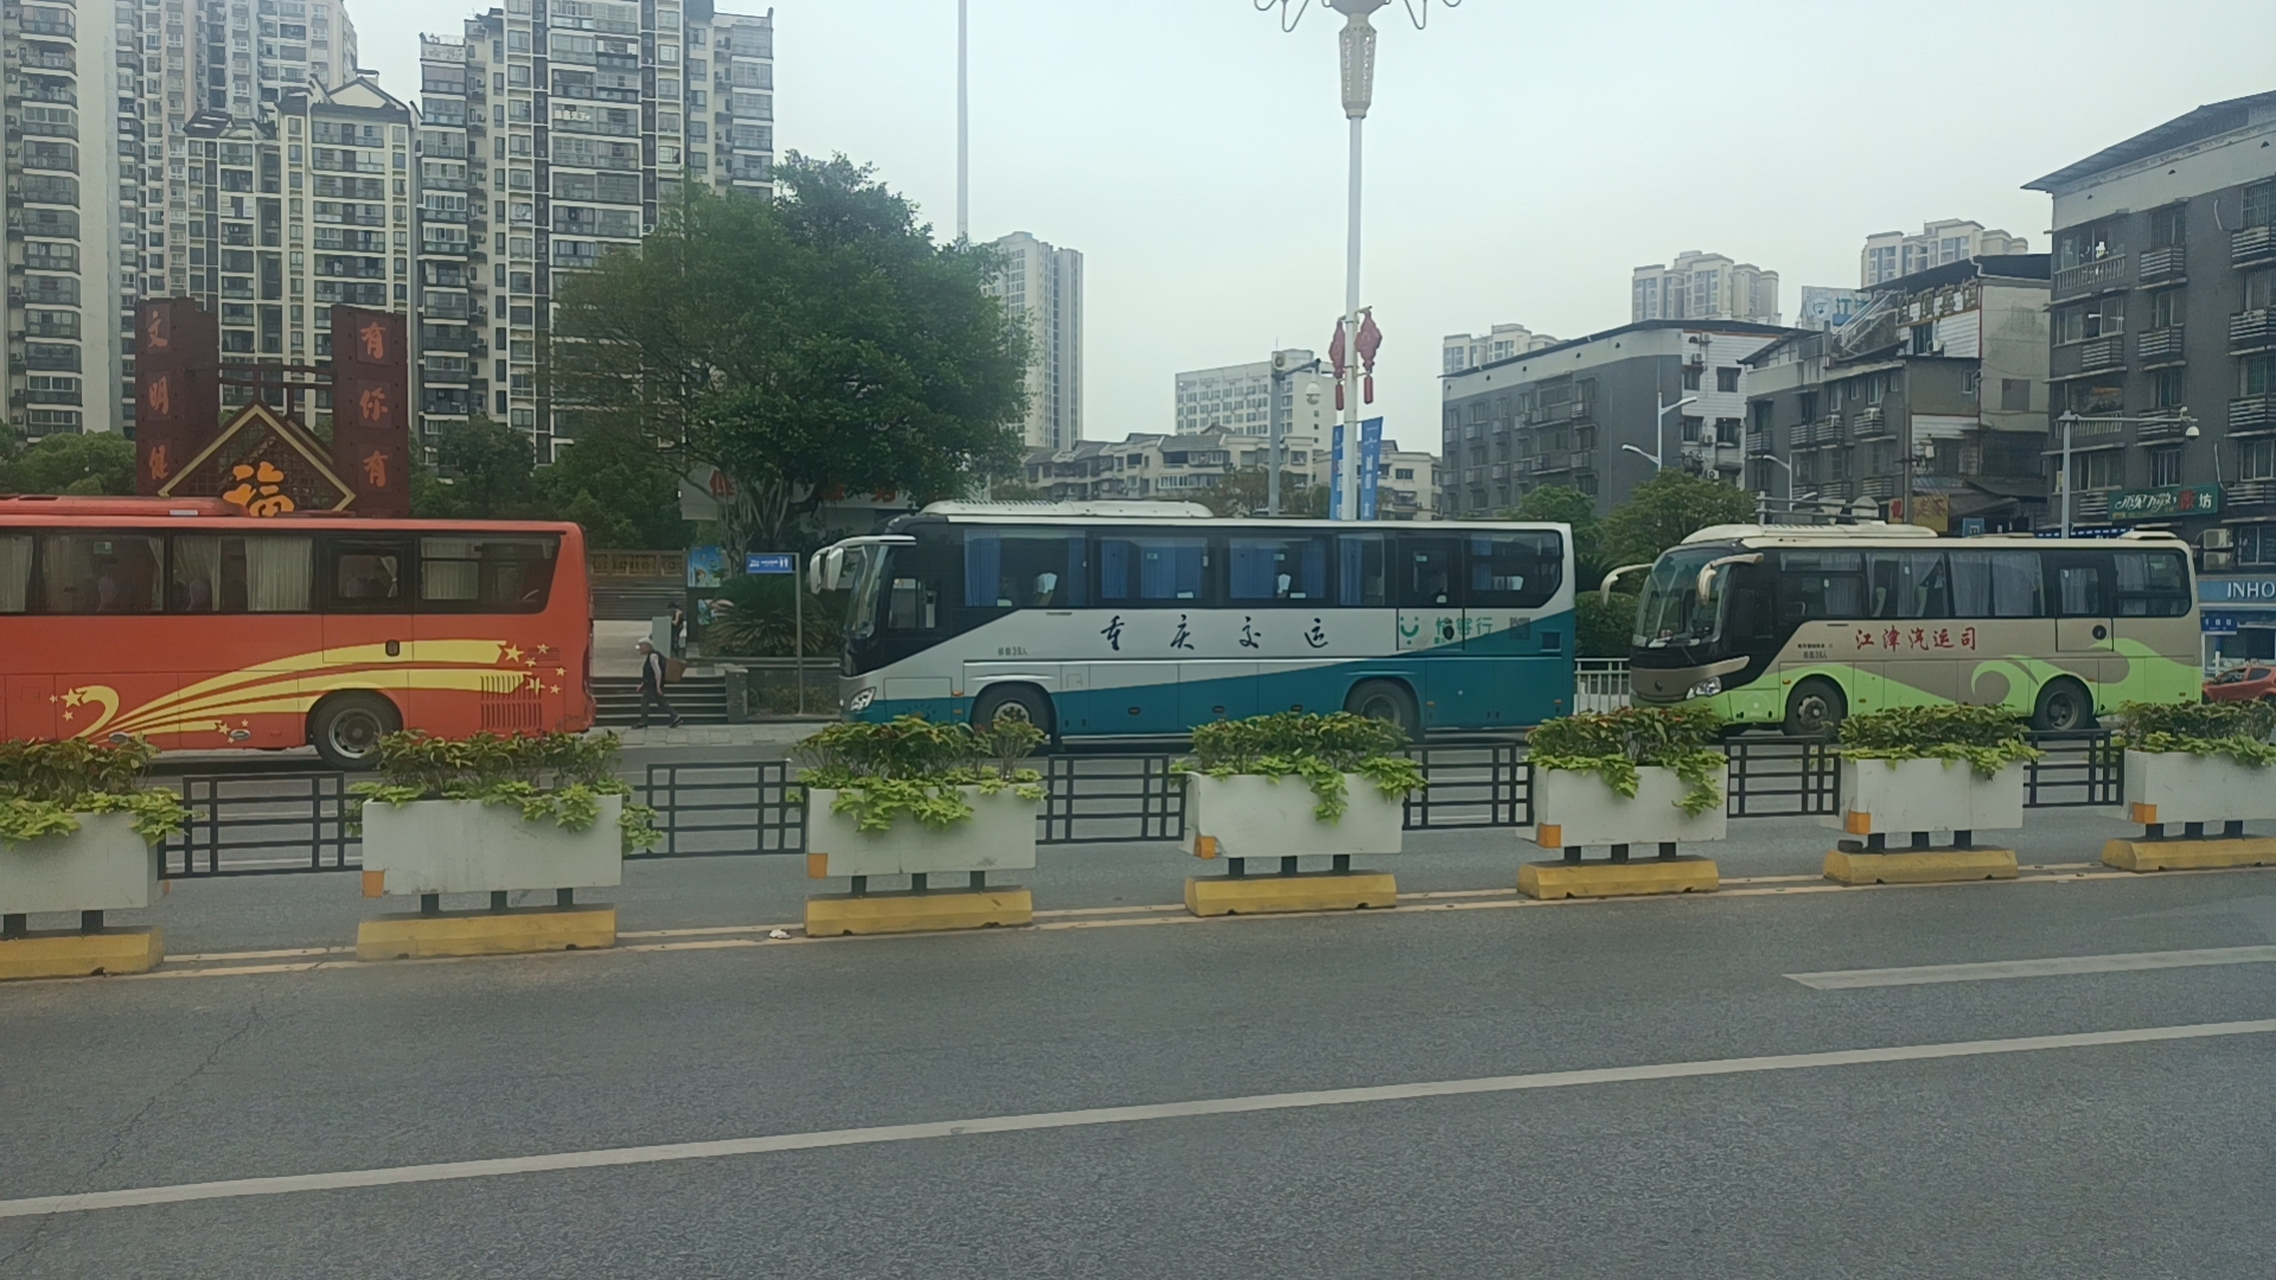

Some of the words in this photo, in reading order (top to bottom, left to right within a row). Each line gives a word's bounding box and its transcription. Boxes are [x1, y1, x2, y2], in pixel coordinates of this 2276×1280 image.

[1100, 613, 1329, 651] 重庆交运
[1855, 624, 1976, 652] 江津汽运司
